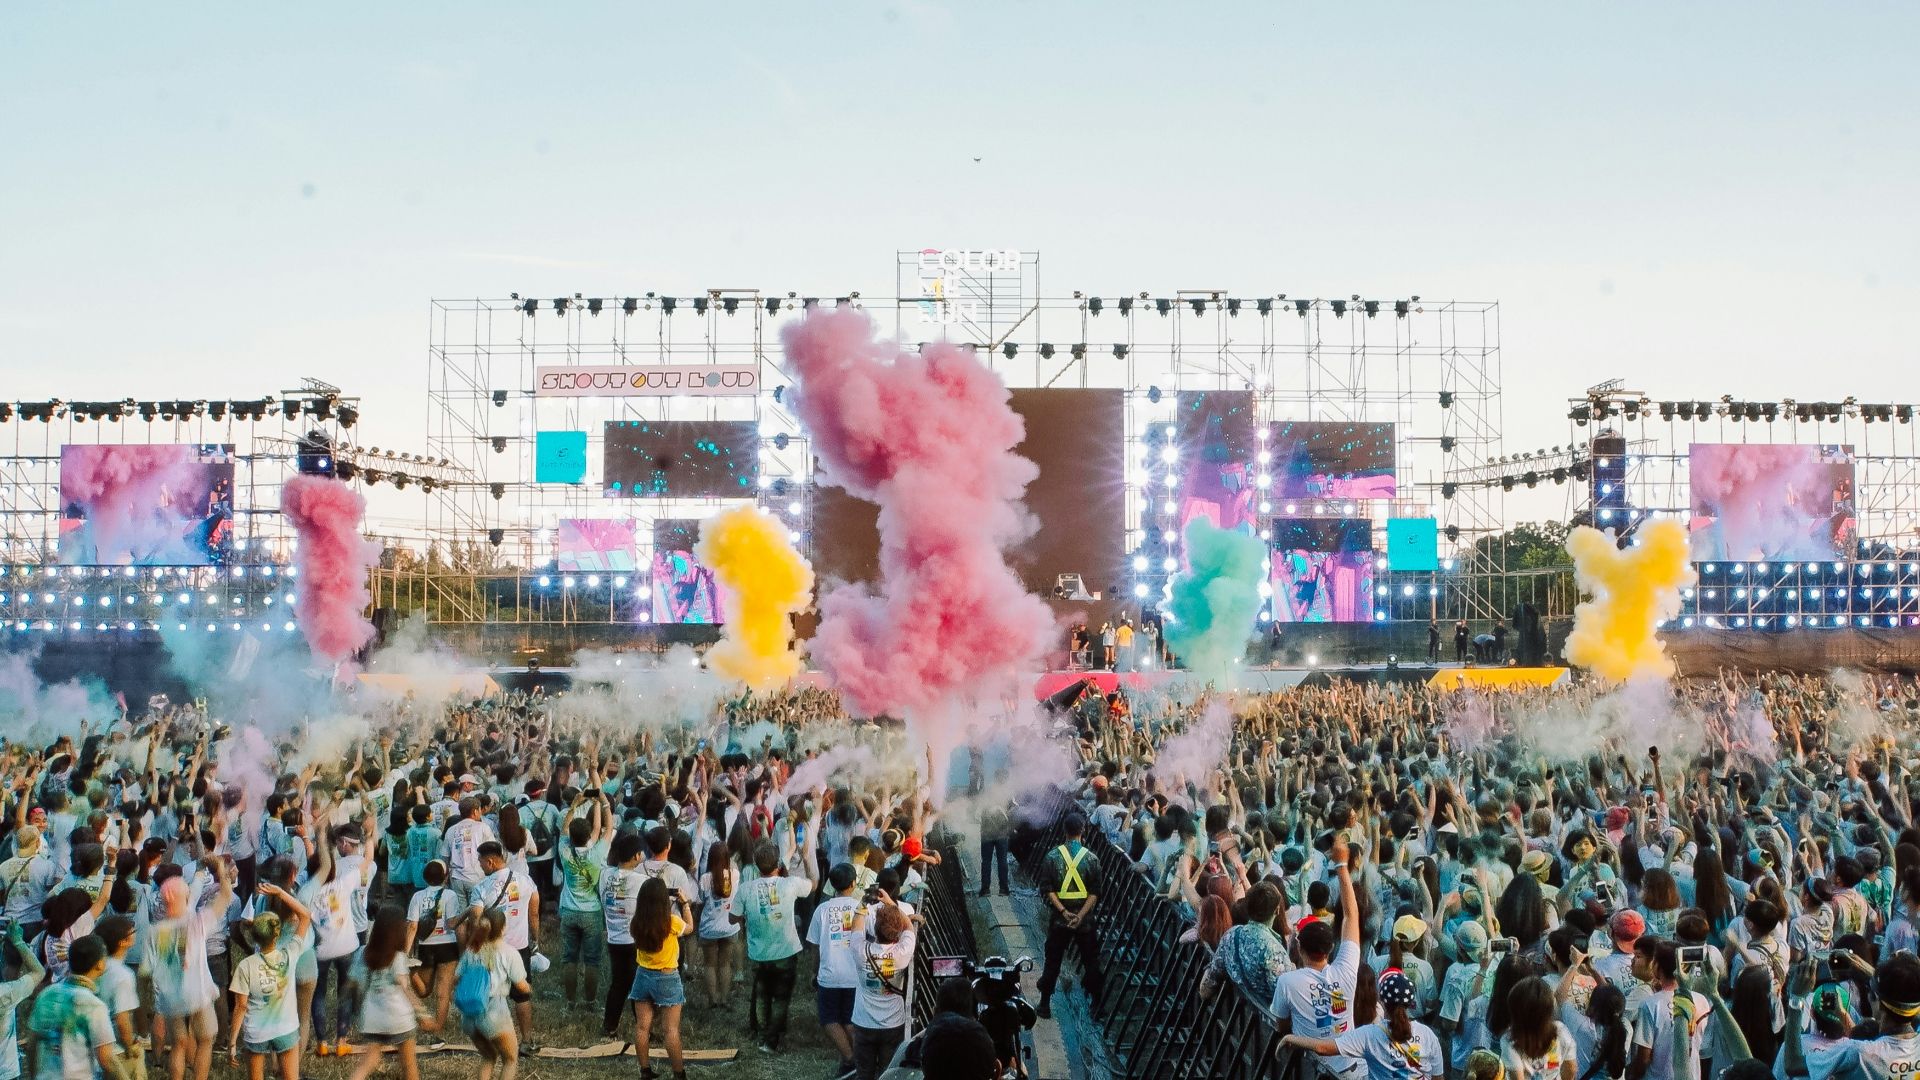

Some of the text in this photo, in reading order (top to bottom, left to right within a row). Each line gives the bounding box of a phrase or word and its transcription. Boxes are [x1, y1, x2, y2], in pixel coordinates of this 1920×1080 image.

[918, 249, 1021, 272] COLOR
[920, 277, 958, 297] ME
[918, 300, 977, 323] RUN
[542, 371, 755, 389] SHOUT OUT LOUD
[1310, 981, 1340, 991] COLOR
[1312, 998, 1331, 1007] RUN
